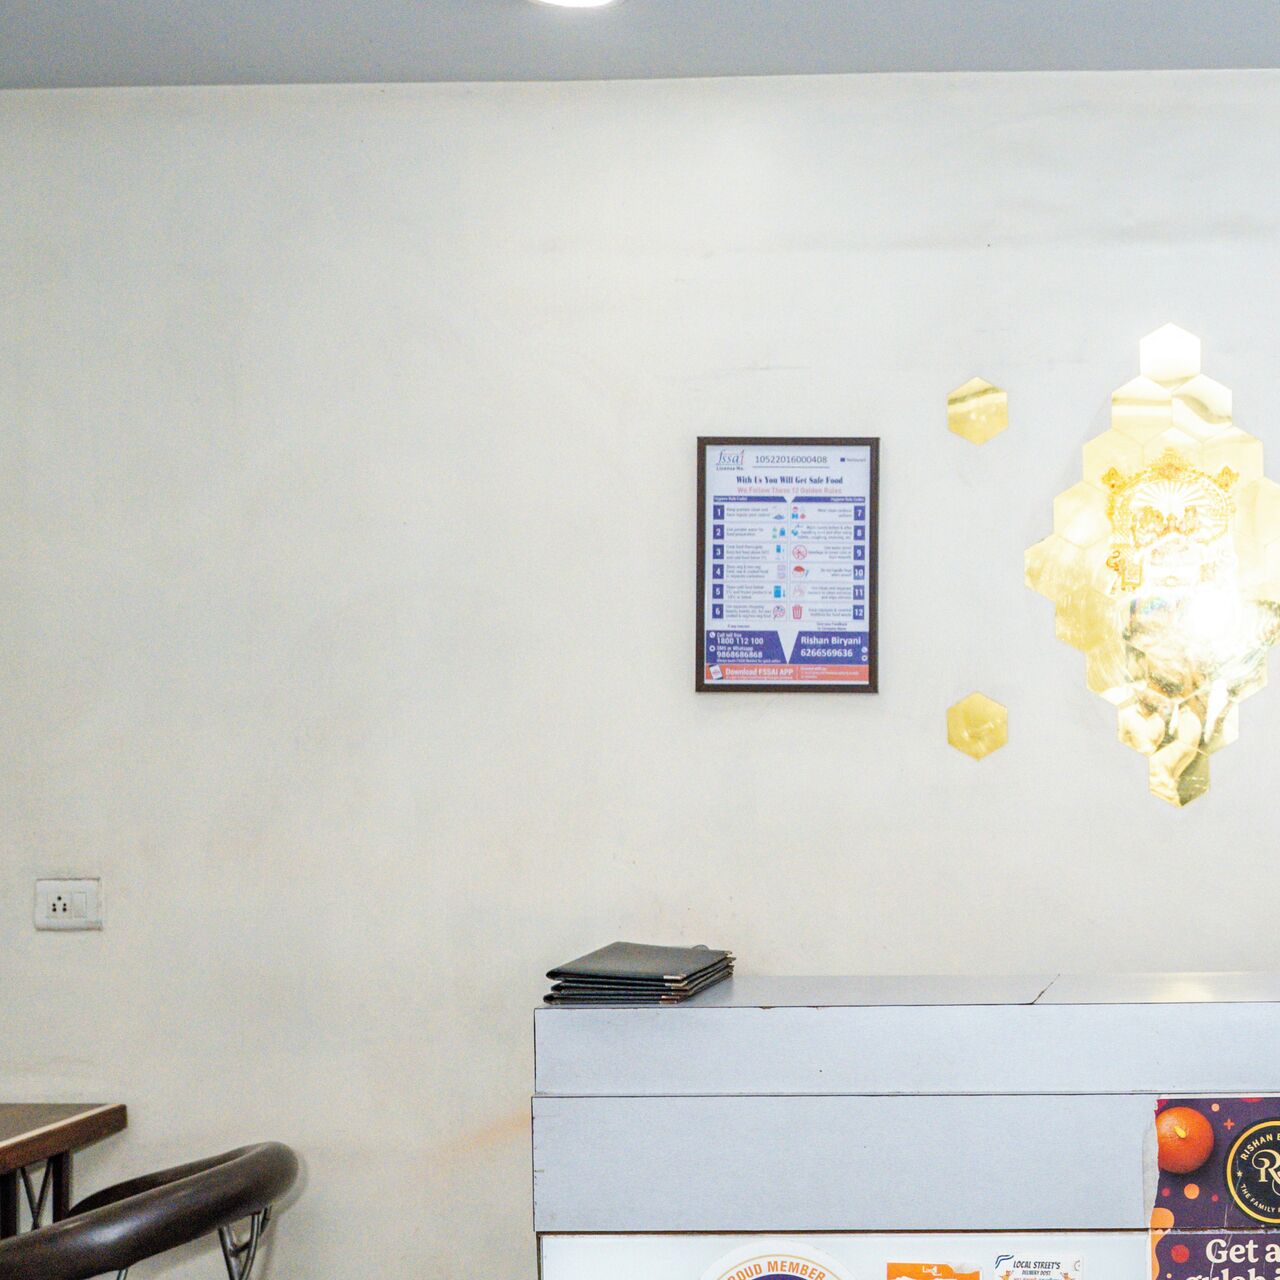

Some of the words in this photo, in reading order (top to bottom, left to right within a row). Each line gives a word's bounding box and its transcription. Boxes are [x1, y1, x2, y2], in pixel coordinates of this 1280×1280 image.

[755, 456, 828, 464] 10522016000408
[737, 476, 751, 484] With
[765, 476, 777, 484] You
[780, 476, 793, 484] Will
[795, 476, 806, 484] Get
[809, 476, 823, 484] Safe
[826, 476, 843, 484] Food
[717, 508, 721, 516] 1
[856, 509, 862, 517] 7
[716, 528, 721, 536] 2
[857, 529, 862, 537] 8
[716, 548, 721, 556] 3
[856, 549, 862, 557] 9
[855, 609, 863, 617] 12
[801, 636, 829, 644] Rishan
[831, 636, 861, 646] Biryani
[801, 649, 853, 657] 6266569636
[726, 668, 757, 676] Download
[759, 668, 778, 676] FSSAI
[779, 668, 794, 676] APP
[1240, 1133, 1273, 1161] RISHAN
[1240, 1183, 1251, 1200] THE
[1250, 1197, 1276, 1213] FAMILY
[1205, 1238, 1259, 1264] Get
[1013, 1260, 1031, 1268] LOCAL
[1032, 1261, 1061, 1269] STREET'S
